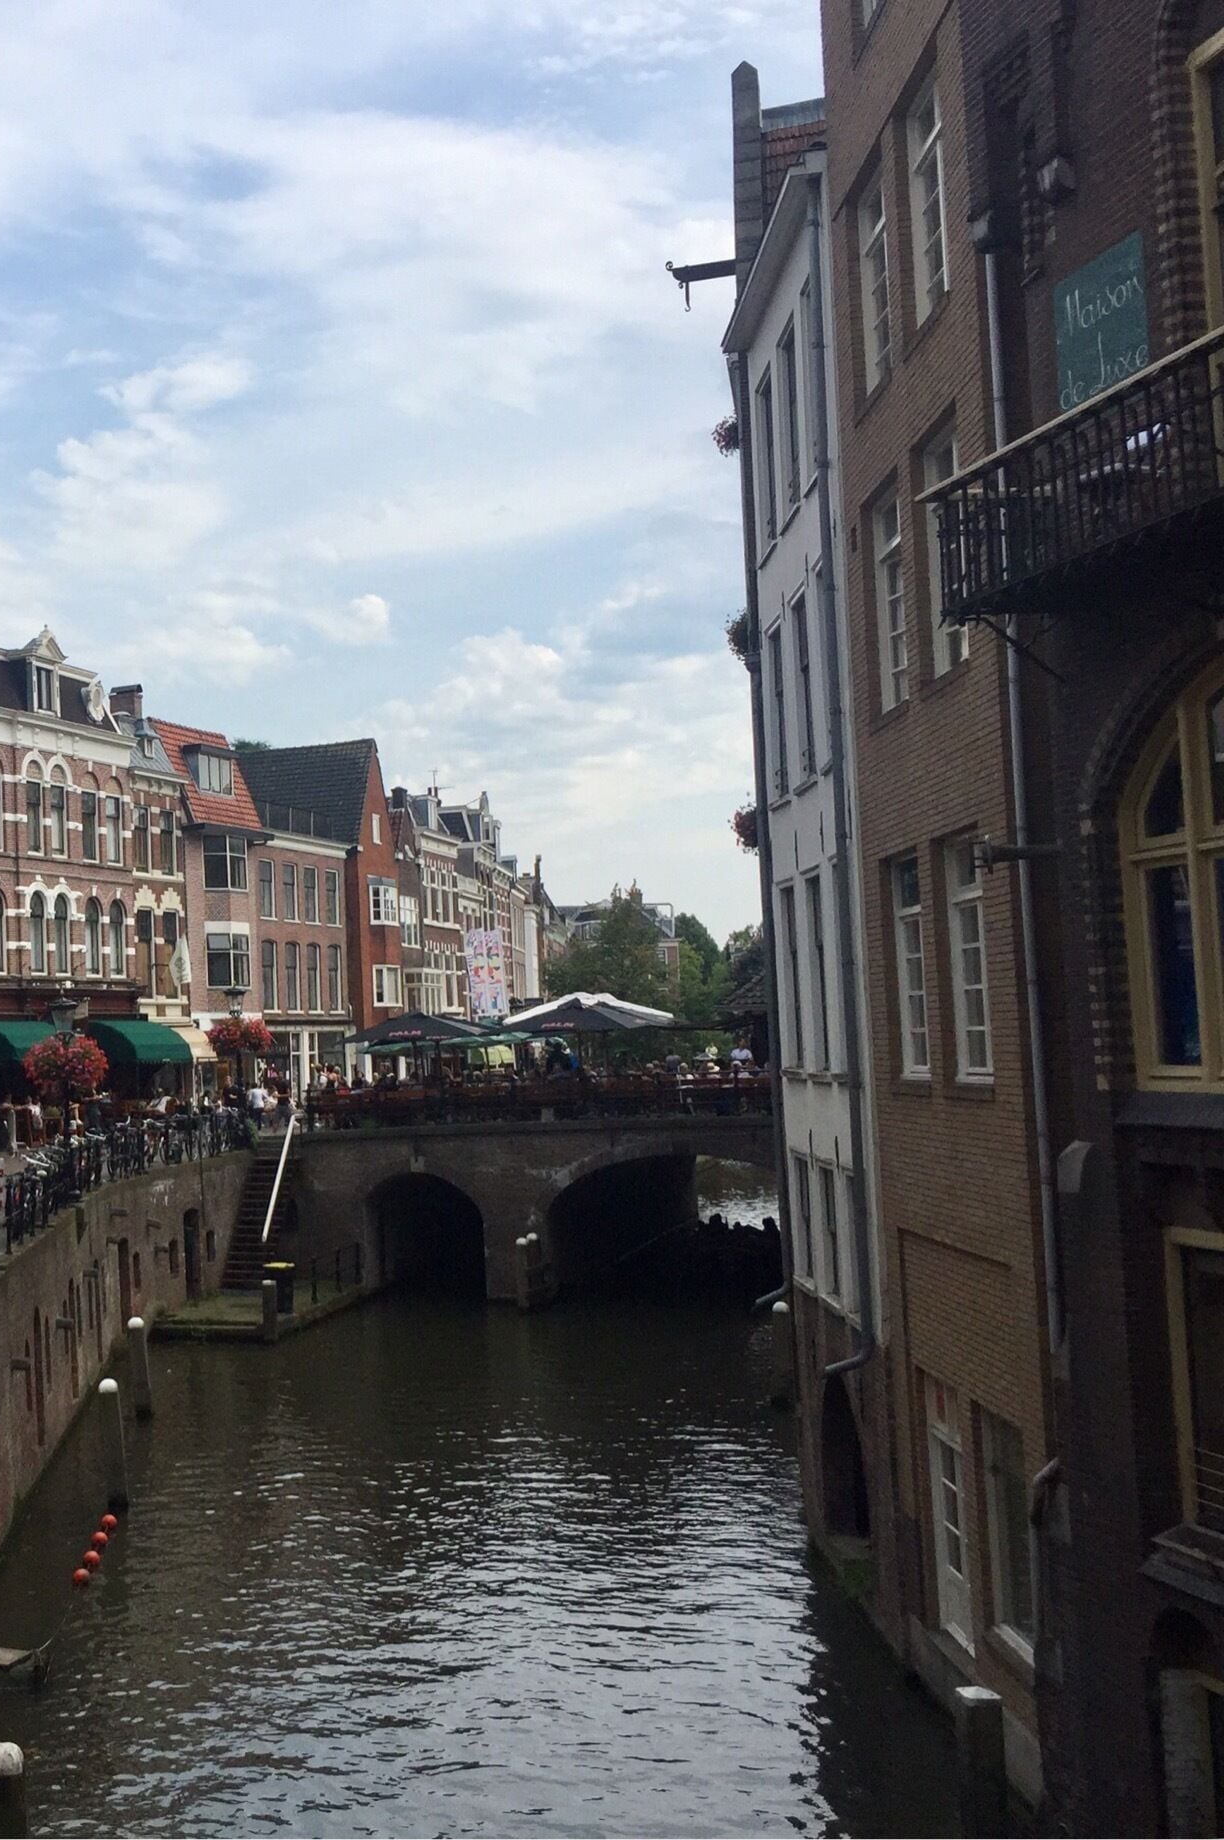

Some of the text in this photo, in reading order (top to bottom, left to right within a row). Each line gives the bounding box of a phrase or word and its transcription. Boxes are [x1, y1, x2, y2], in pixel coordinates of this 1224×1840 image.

[1066, 275, 1143, 336] Maison
[1060, 331, 1149, 410] de Luxe
